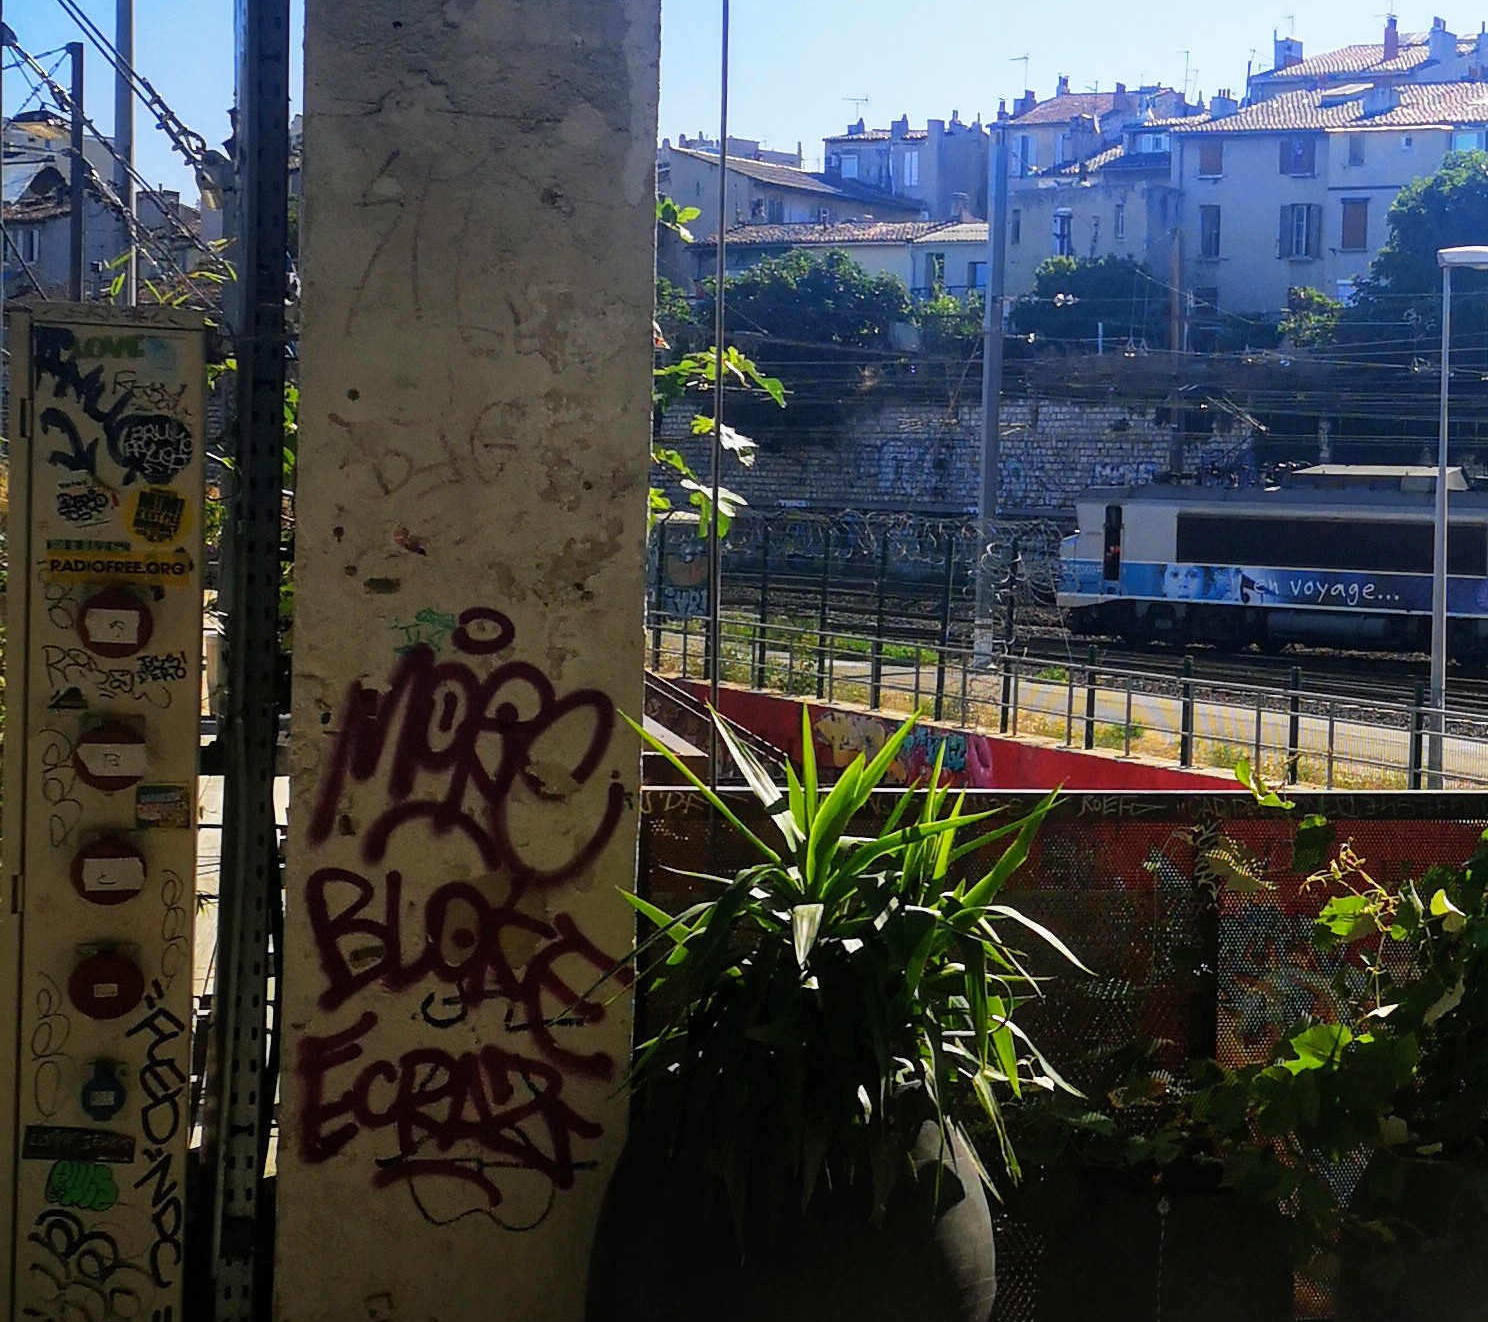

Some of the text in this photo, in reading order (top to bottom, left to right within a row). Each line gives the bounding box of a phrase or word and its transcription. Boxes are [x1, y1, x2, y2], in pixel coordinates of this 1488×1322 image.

[50, 559, 185, 576] RADIOFREE.ORG
[1253, 579, 1400, 606] en voyage...
